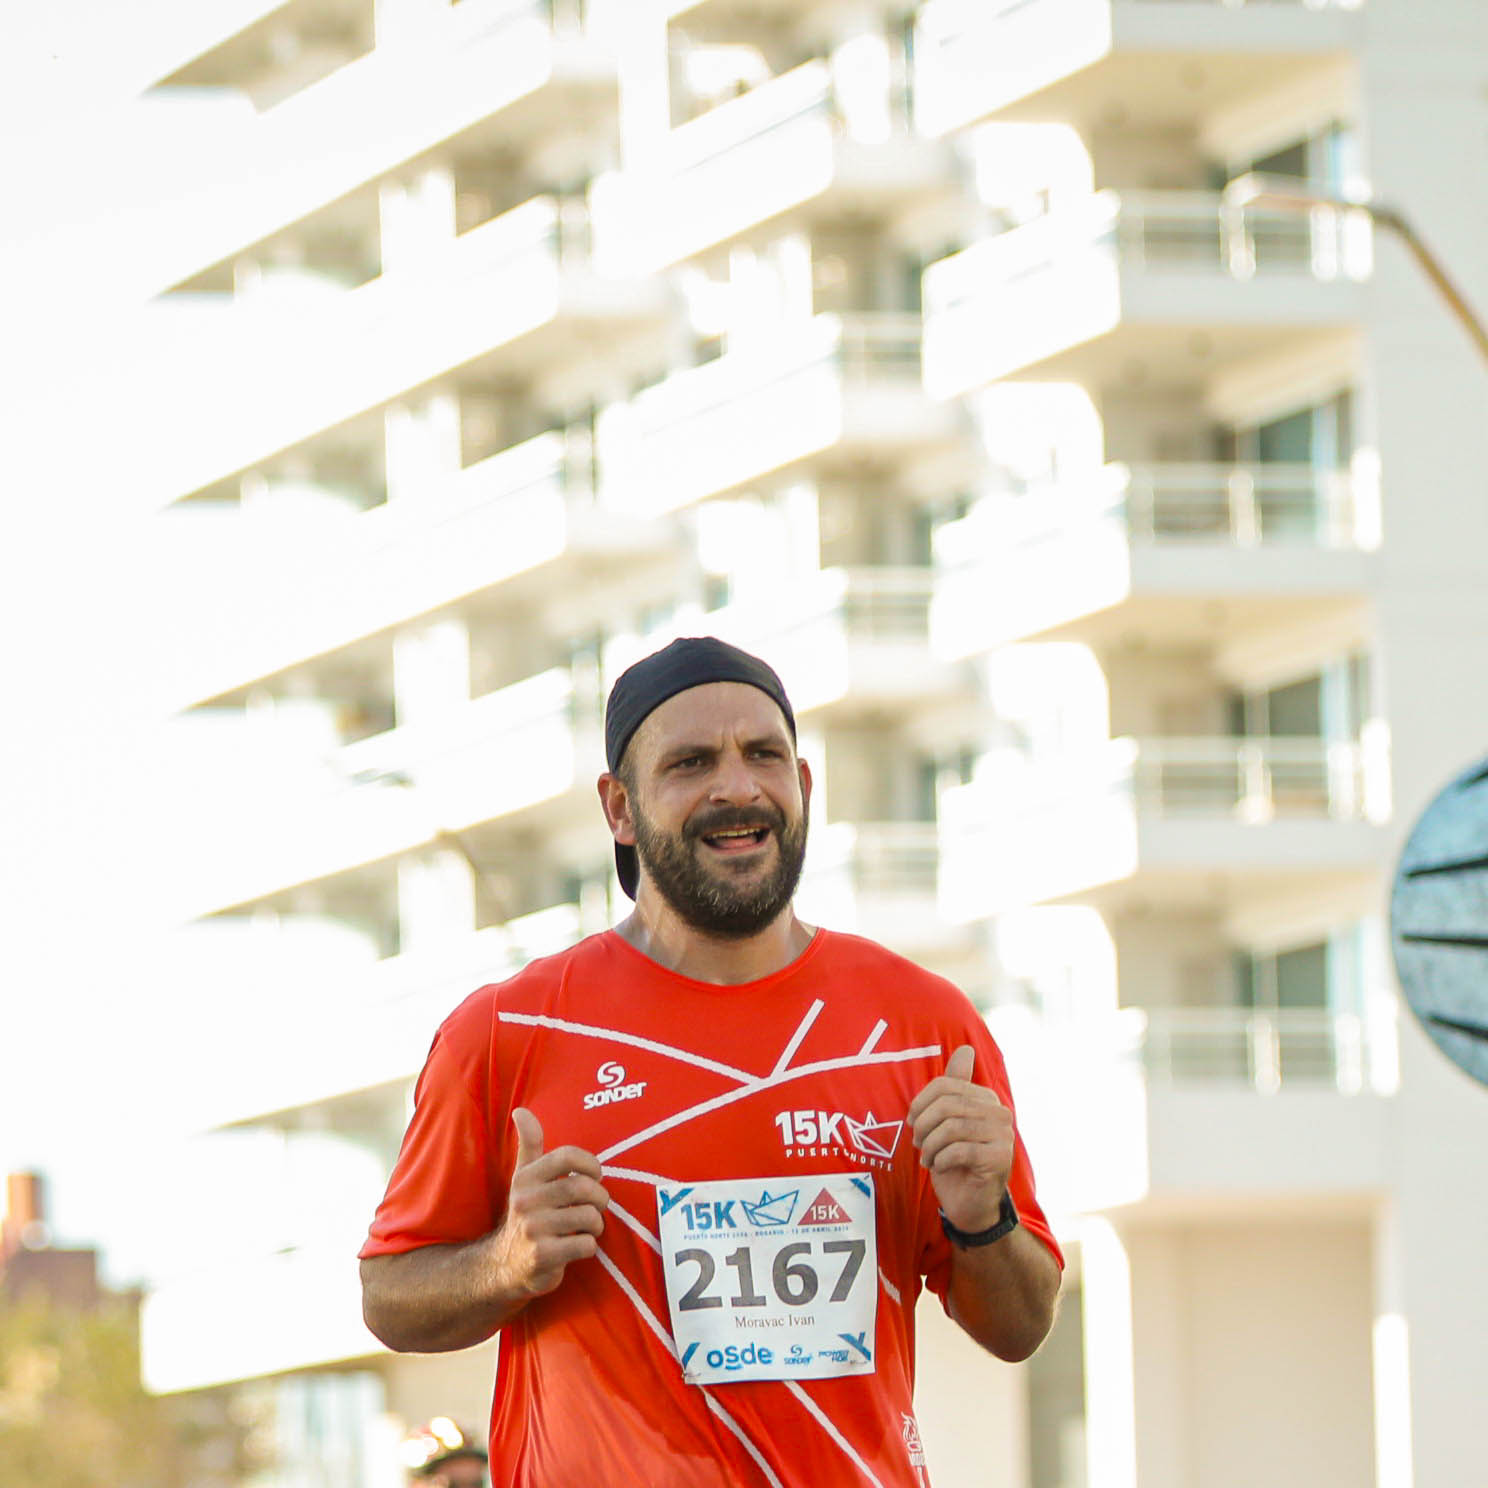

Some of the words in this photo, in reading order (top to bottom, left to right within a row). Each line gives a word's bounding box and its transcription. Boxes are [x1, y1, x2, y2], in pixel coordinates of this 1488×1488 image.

[775, 1110, 844, 1146] 15K
[680, 1200, 737, 1230] 15K
[811, 1204, 840, 1220] 15K
[674, 1239, 867, 1312] 2167
[789, 1314, 815, 1327] Ivan
[706, 1342, 773, 1370] osde
